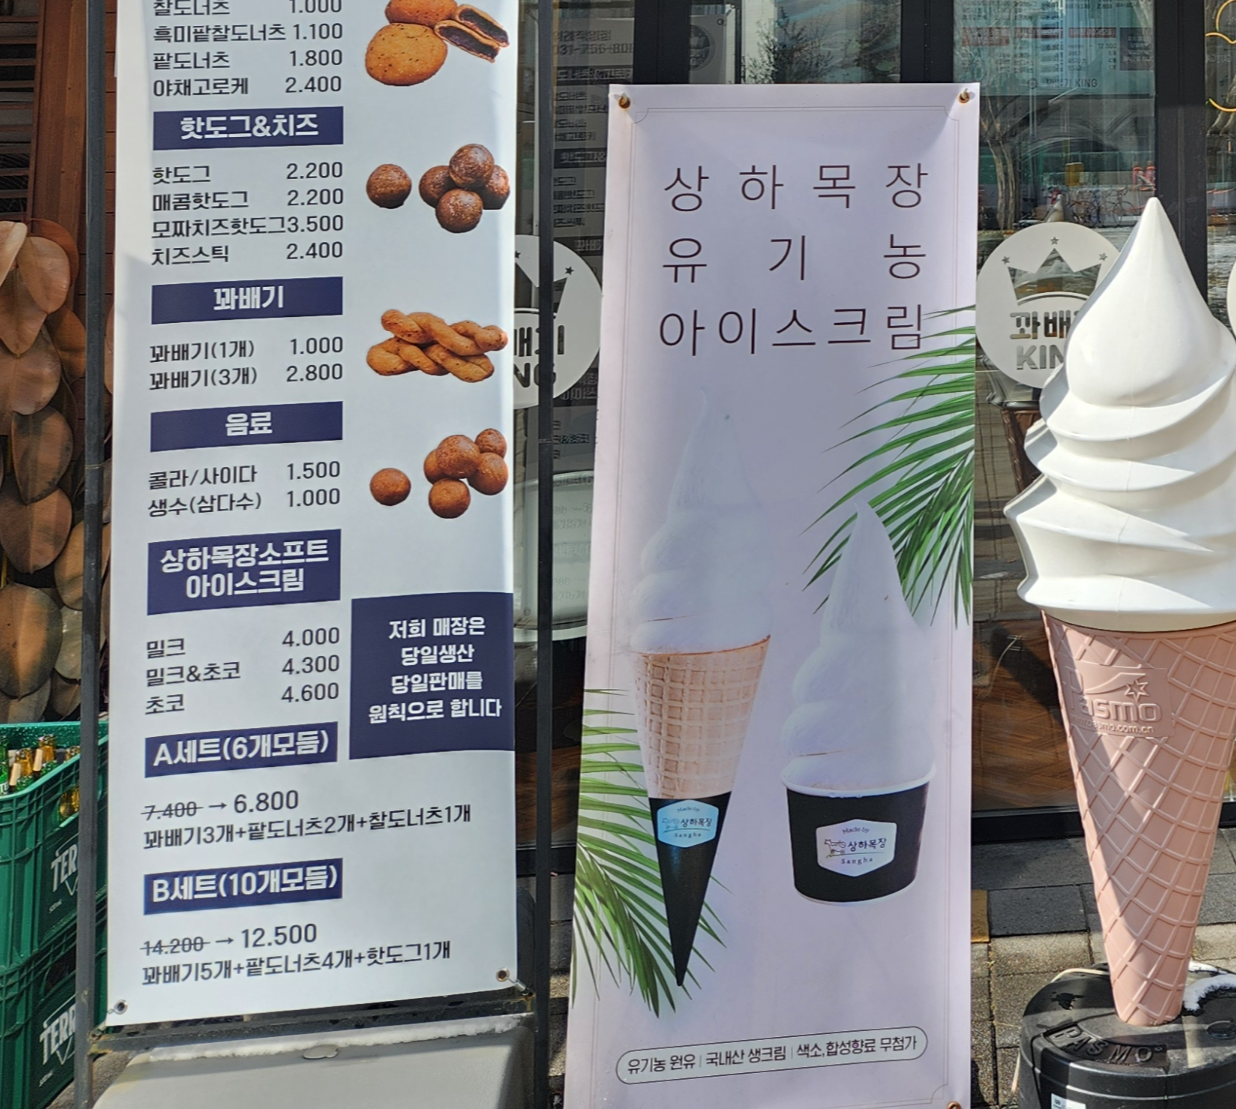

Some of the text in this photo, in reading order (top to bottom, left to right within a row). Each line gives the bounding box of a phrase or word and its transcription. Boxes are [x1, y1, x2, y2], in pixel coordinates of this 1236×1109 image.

[153, 23, 343, 44] 흑미팥찰도너츠 1.100
[153, 49, 342, 71] 팥도너츠 1.800
[153, 75, 342, 97] 야채고로케 2.400
[180, 113, 319, 141] 핫도그&치즈
[153, 161, 343, 186] 핫도그 2.200
[152, 187, 344, 212] 매콤핫도그 2.200
[151, 214, 344, 239] 모짜치즈핫도그 3.500
[151, 241, 343, 266] 치즈스틱 2.400
[213, 285, 285, 312] 꽈배기
[659, 304, 923, 357] 아이스크림
[1010, 310, 1078, 340] 꽈배
[149, 336, 343, 364] 꽈배기(1개) 1.000
[1016, 344, 1065, 371] KIN
[149, 363, 343, 390] 꽈배기(3개) 2.800
[225, 411, 273, 436] 음료
[148, 461, 341, 490] 콜라/사이다 1.500
[147, 488, 341, 518] 생수(삼다수) 1.000
[160, 539, 329, 574] 상하목장소프트
[184, 568, 305, 599] 아이스크림
[388, 616, 486, 640] 저희 매장은
[146, 627, 340, 659] 밀크 4.000
[401, 644, 475, 666] 당일생산
[146, 654, 340, 687] 밀크&초코 4.300
[391, 671, 483, 694] 당일판매를
[145, 682, 340, 716] 초코 4.600
[368, 698, 502, 724] 원칙으로 합니다
[153, 730, 330, 767] A세트(6개모듬)
[233, 789, 299, 815] 6.800
[143, 804, 472, 850] 꽈배기3개+팥도너츠2개+찰도너츠1개
[680, 818, 712, 828] 상하목장
[847, 837, 887, 852] 상하목장
[51, 844, 79, 892] TER
[840, 856, 873, 866] Sangha
[152, 865, 338, 903] B세트(10개모듬)
[241, 923, 317, 948] 12.500
[142, 941, 451, 987] 꽈배기5개+팥도너츠4개+핫도그1개
[40, 1004, 77, 1065] TERR
[1048, 1026, 1152, 1063] PASMO
[627, 1058, 666, 1075] 유기농
[669, 1054, 696, 1071] 원유
[705, 1049, 745, 1067] 국내산
[747, 1046, 786, 1064] 생크림
[879, 1036, 917, 1052] 무첨가
